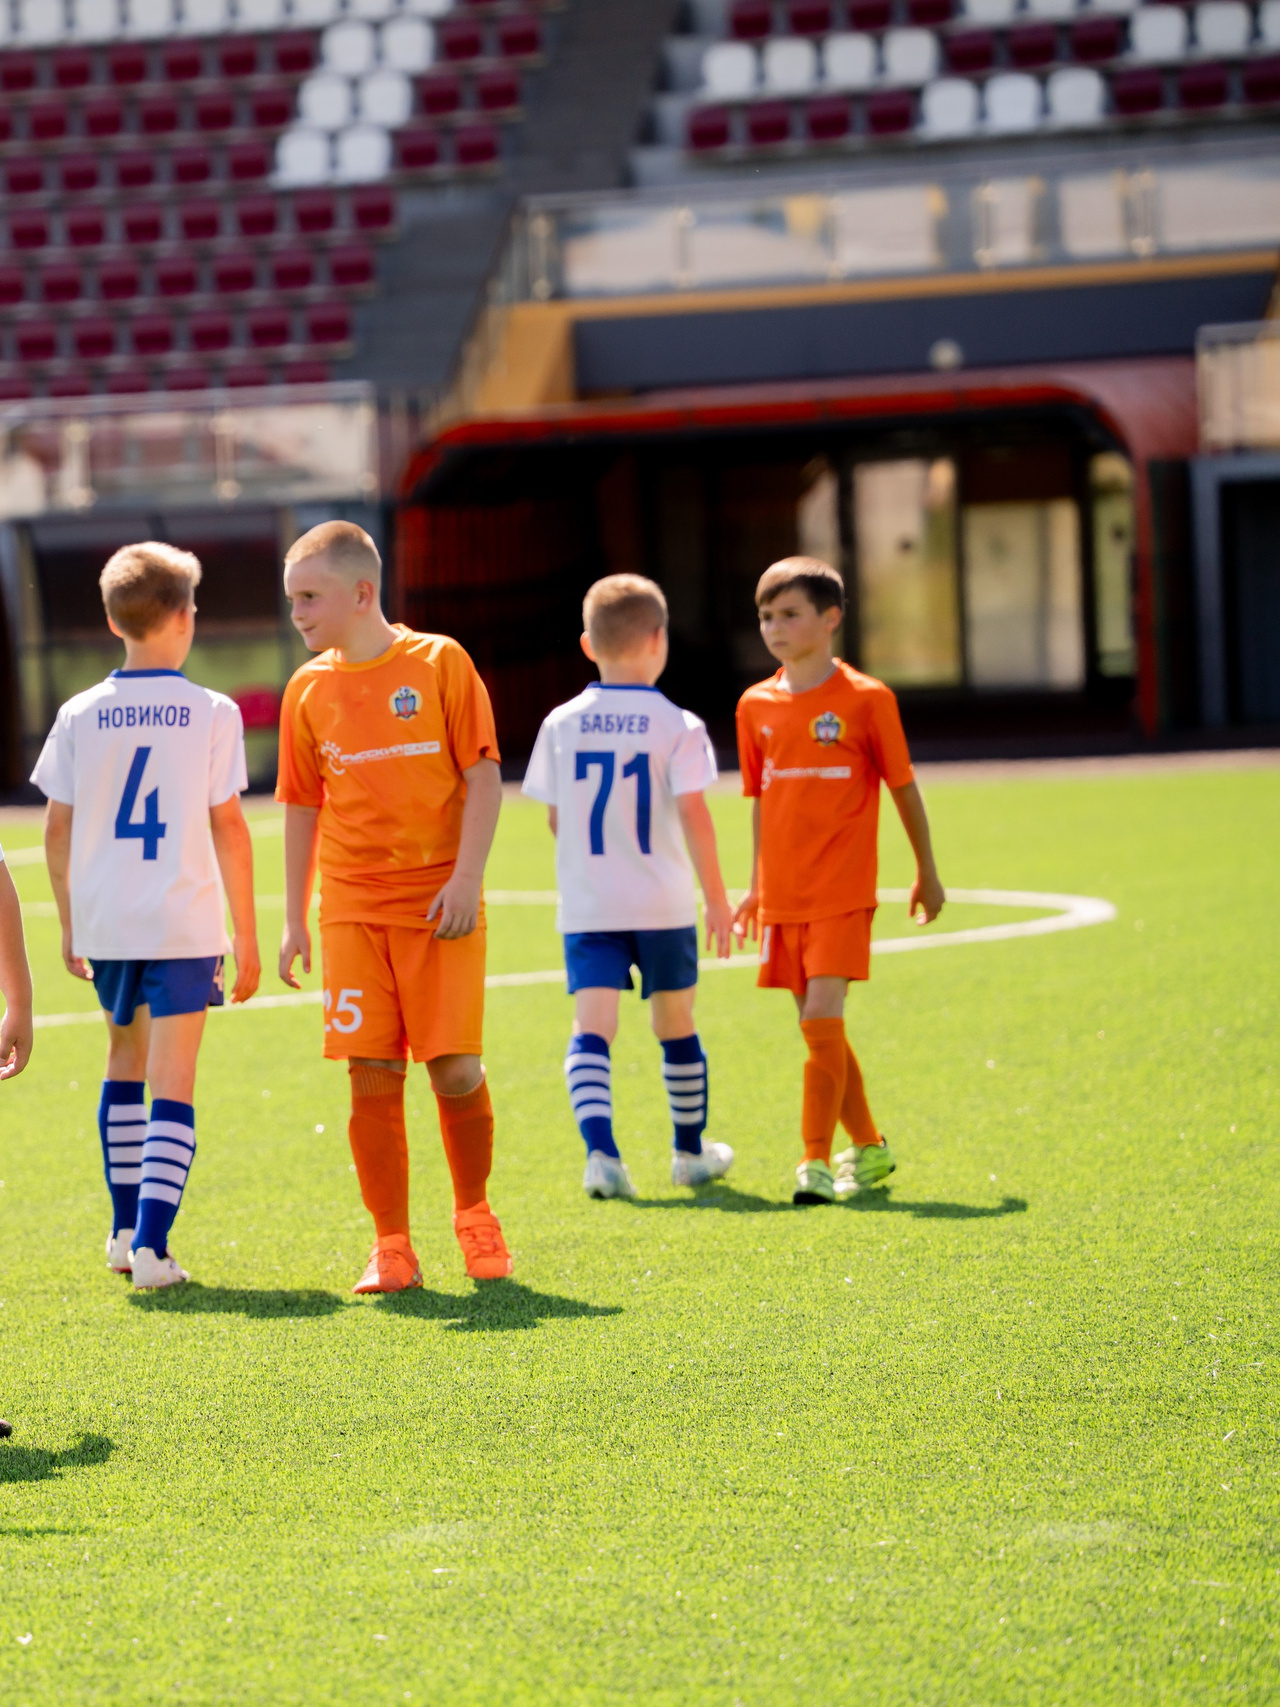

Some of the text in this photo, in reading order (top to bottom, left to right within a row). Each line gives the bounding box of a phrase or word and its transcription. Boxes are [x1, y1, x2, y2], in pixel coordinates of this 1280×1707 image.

[98, 705, 190, 730] НОВИКОВ
[580, 714, 649, 733] БАБУЕВ
[114, 746, 167, 860] 4
[575, 752, 652, 855] 71
